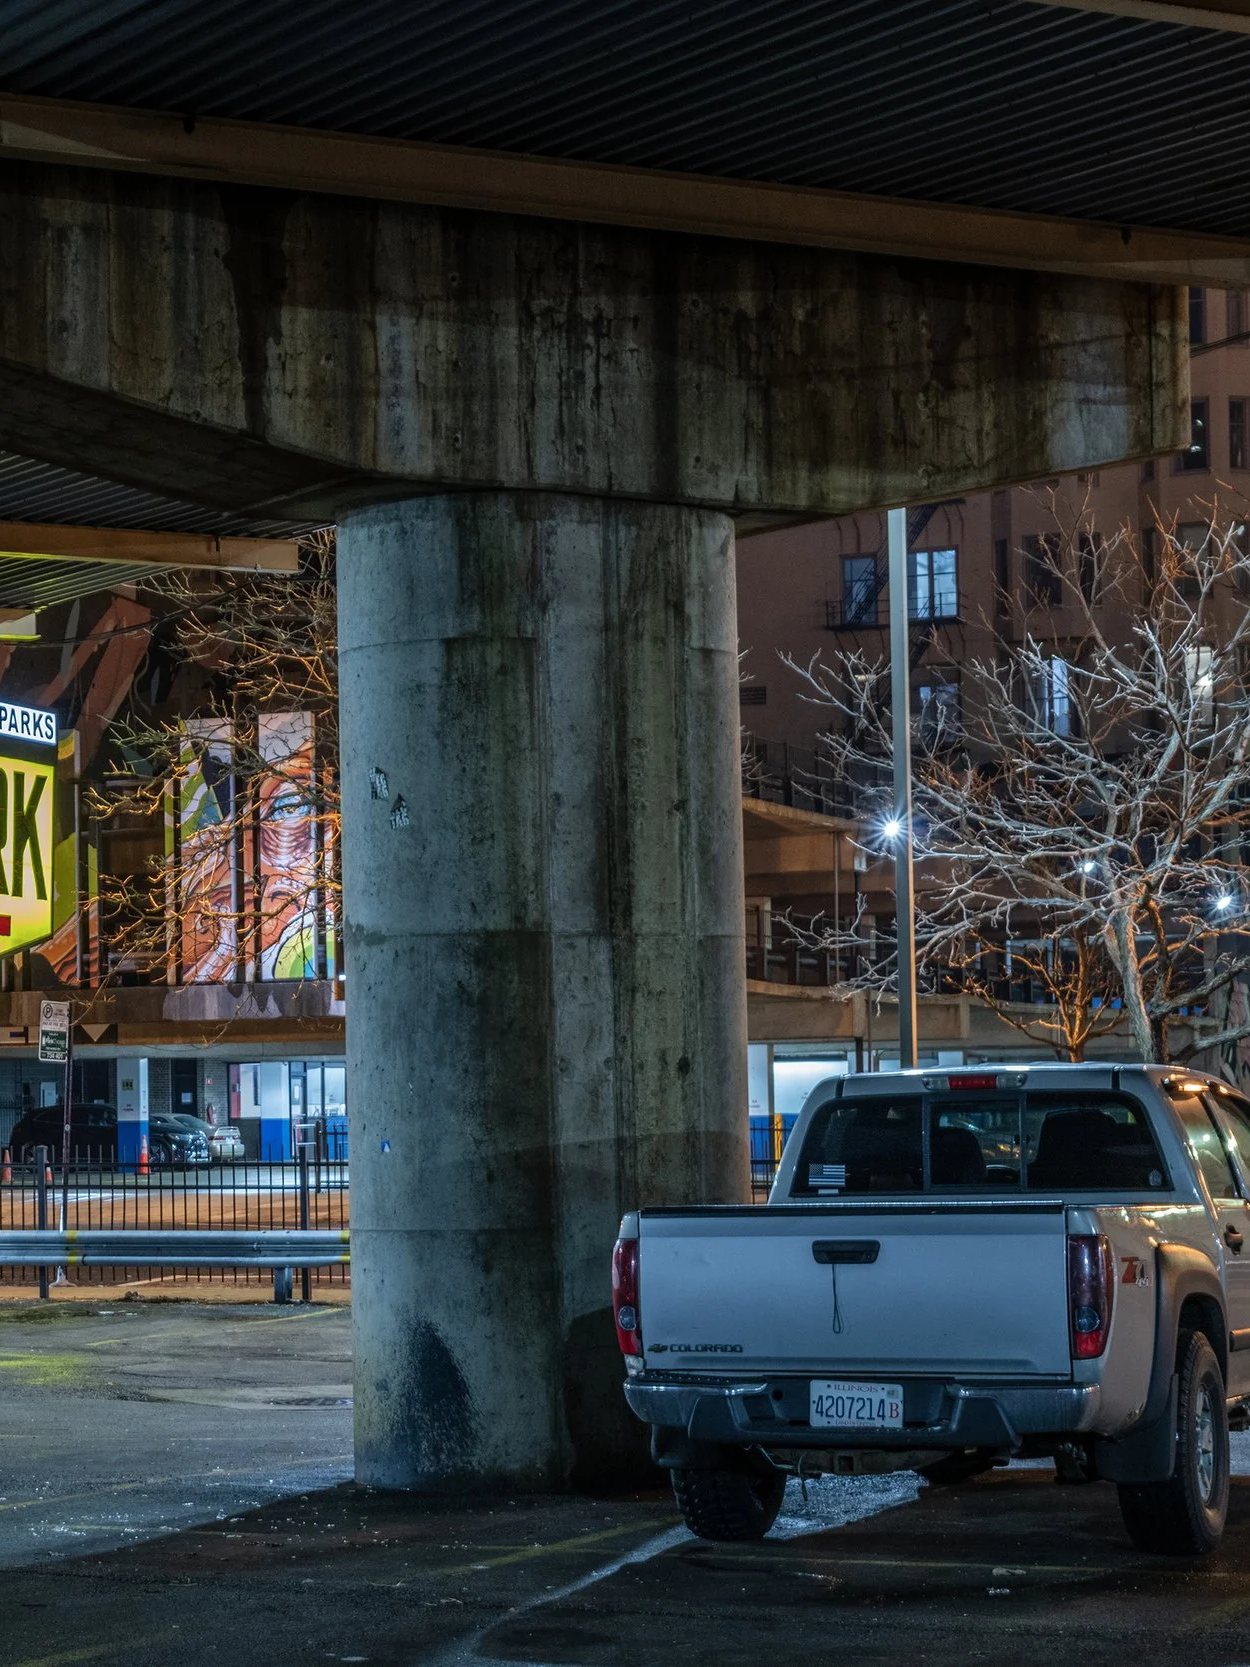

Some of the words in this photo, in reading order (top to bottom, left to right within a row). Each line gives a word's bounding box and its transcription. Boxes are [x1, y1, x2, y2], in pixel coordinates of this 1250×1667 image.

[669, 1343, 743, 1353] COLORADO
[834, 1383, 879, 1393] ILLINOIS
[815, 1395, 886, 1421] 4207214
[889, 1402, 899, 1419] B
